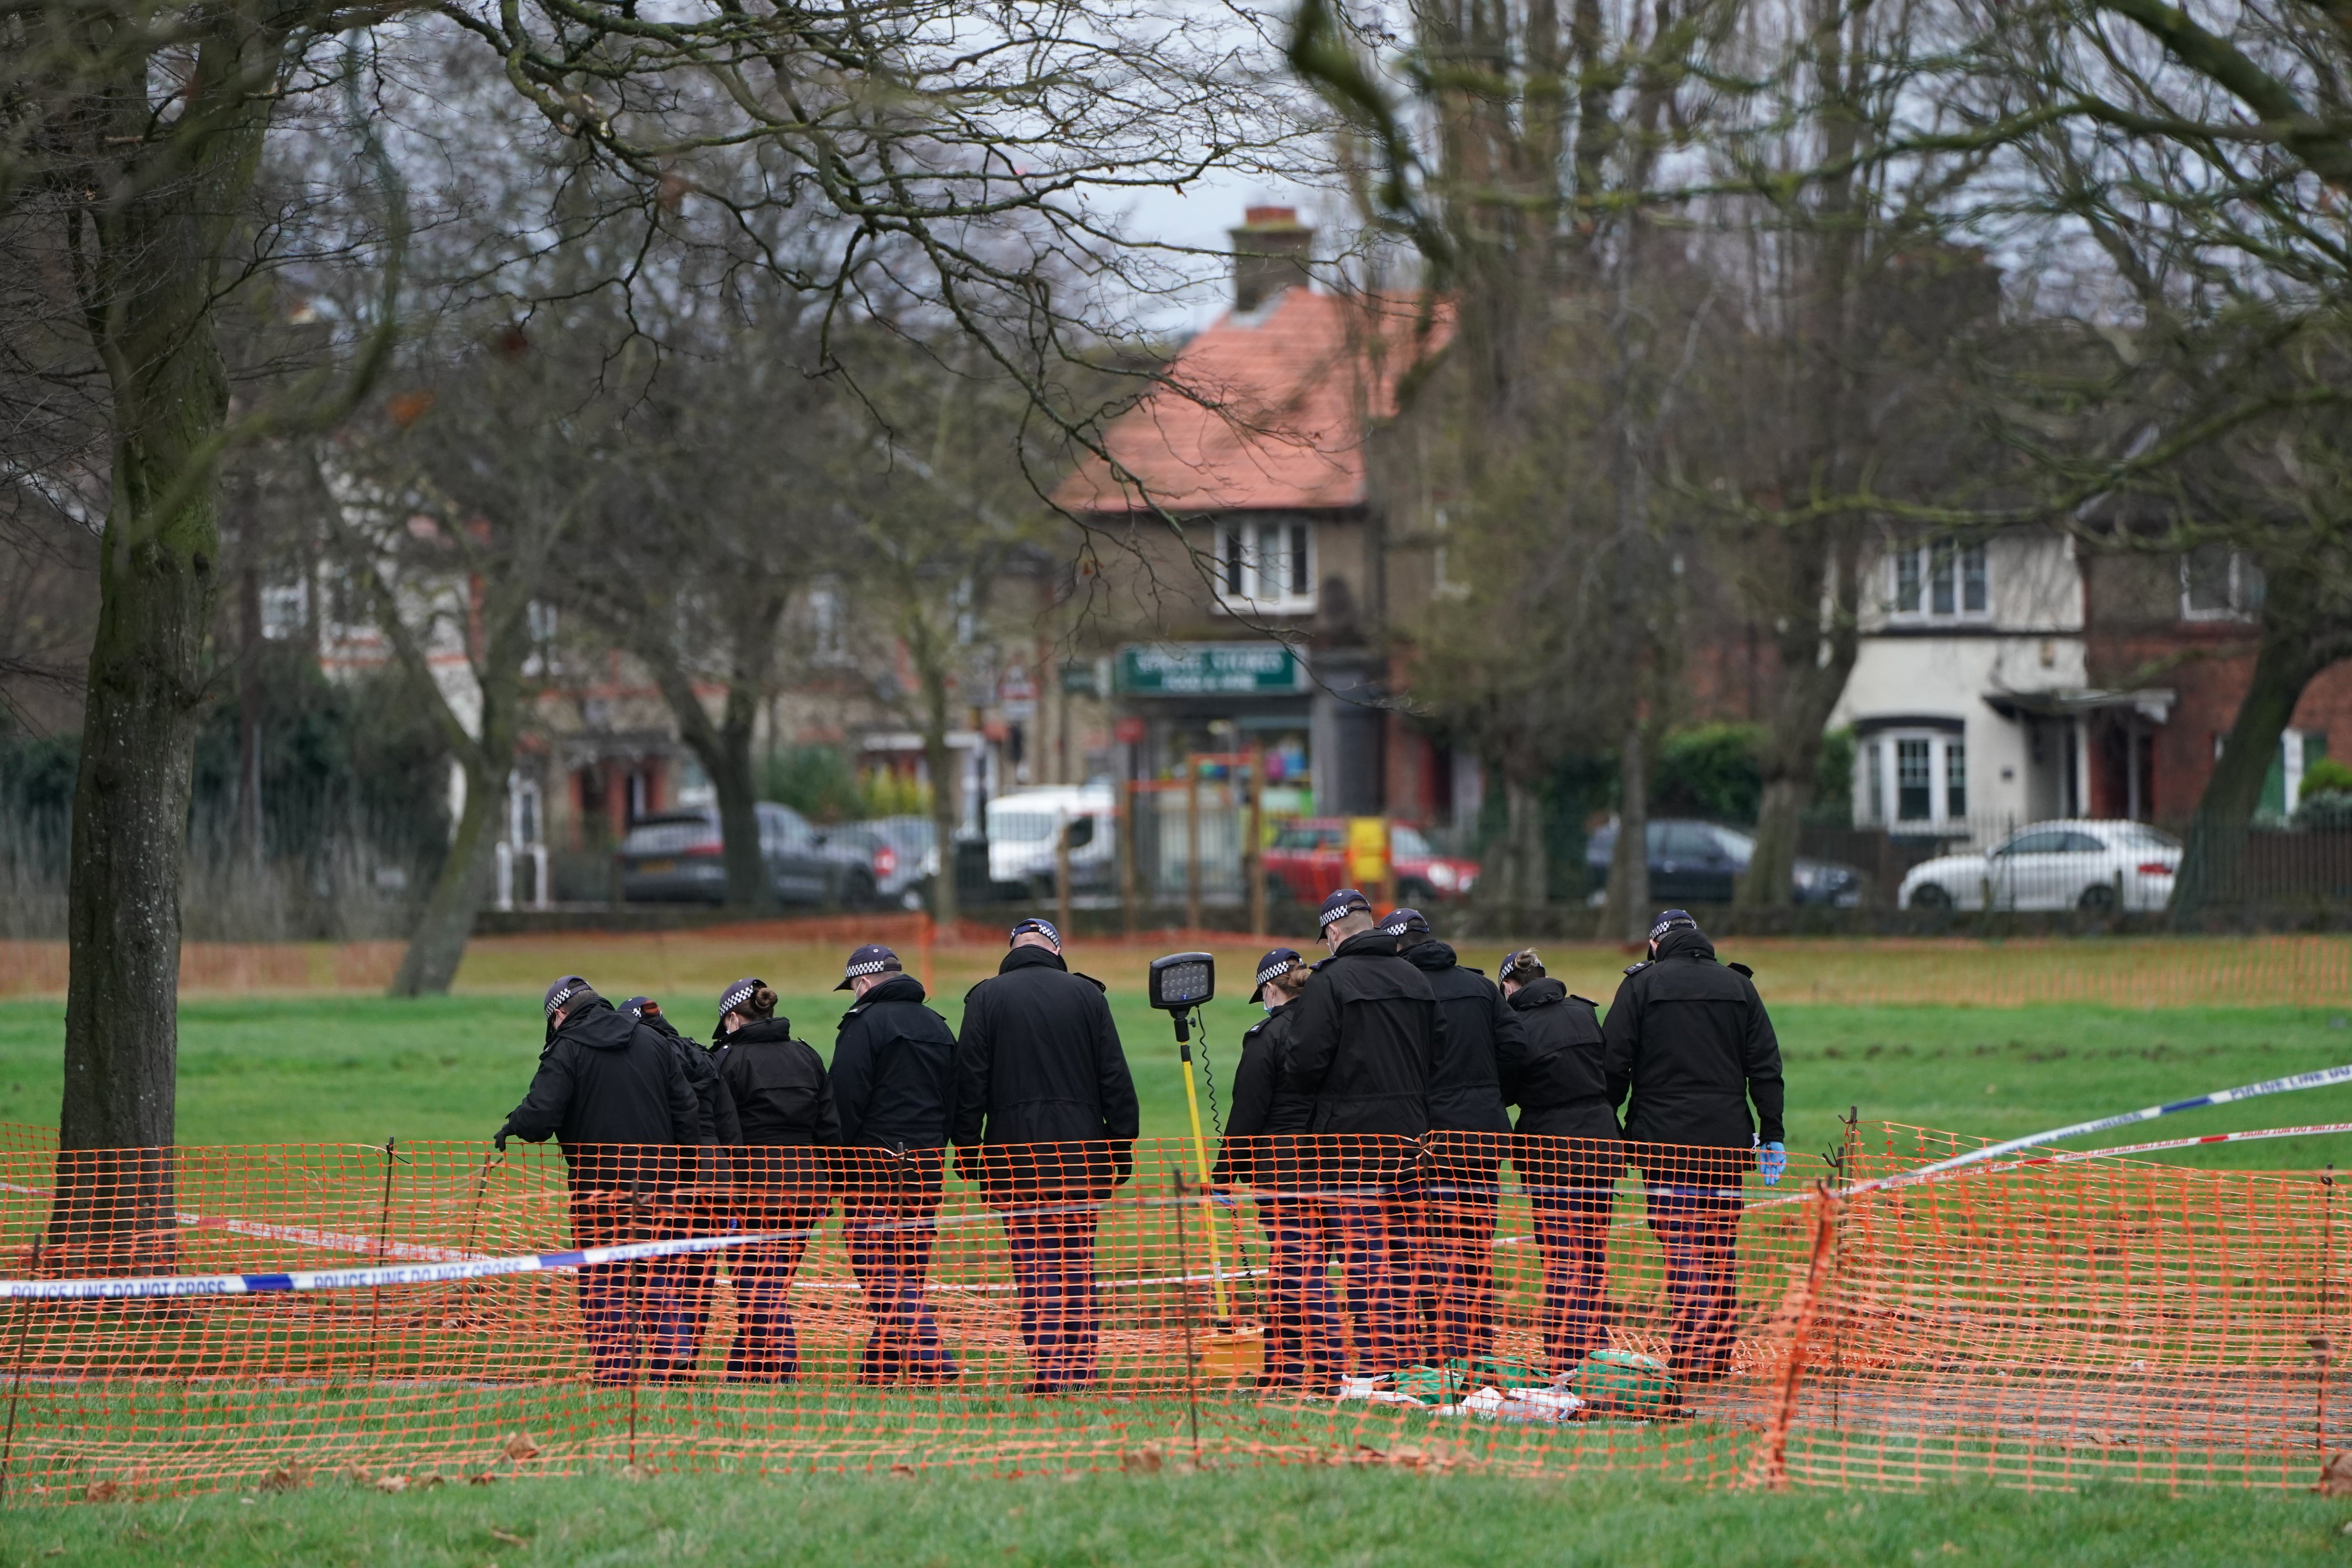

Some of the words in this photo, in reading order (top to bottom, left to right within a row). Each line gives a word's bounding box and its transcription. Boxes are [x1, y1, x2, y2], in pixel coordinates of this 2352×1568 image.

[315, 1273, 367, 1287] POLICE
[373, 1270, 405, 1285] LINE
[411, 1268, 431, 1282] DO
[437, 1266, 467, 1279] NOT
[472, 1261, 522, 1276] CROSS
[11, 1284, 67, 1298] POLICE
[73, 1283, 107, 1297] LINE
[114, 1282, 134, 1297] DO
[140, 1281, 170, 1296] NOT
[177, 1279, 226, 1295] CROSS
